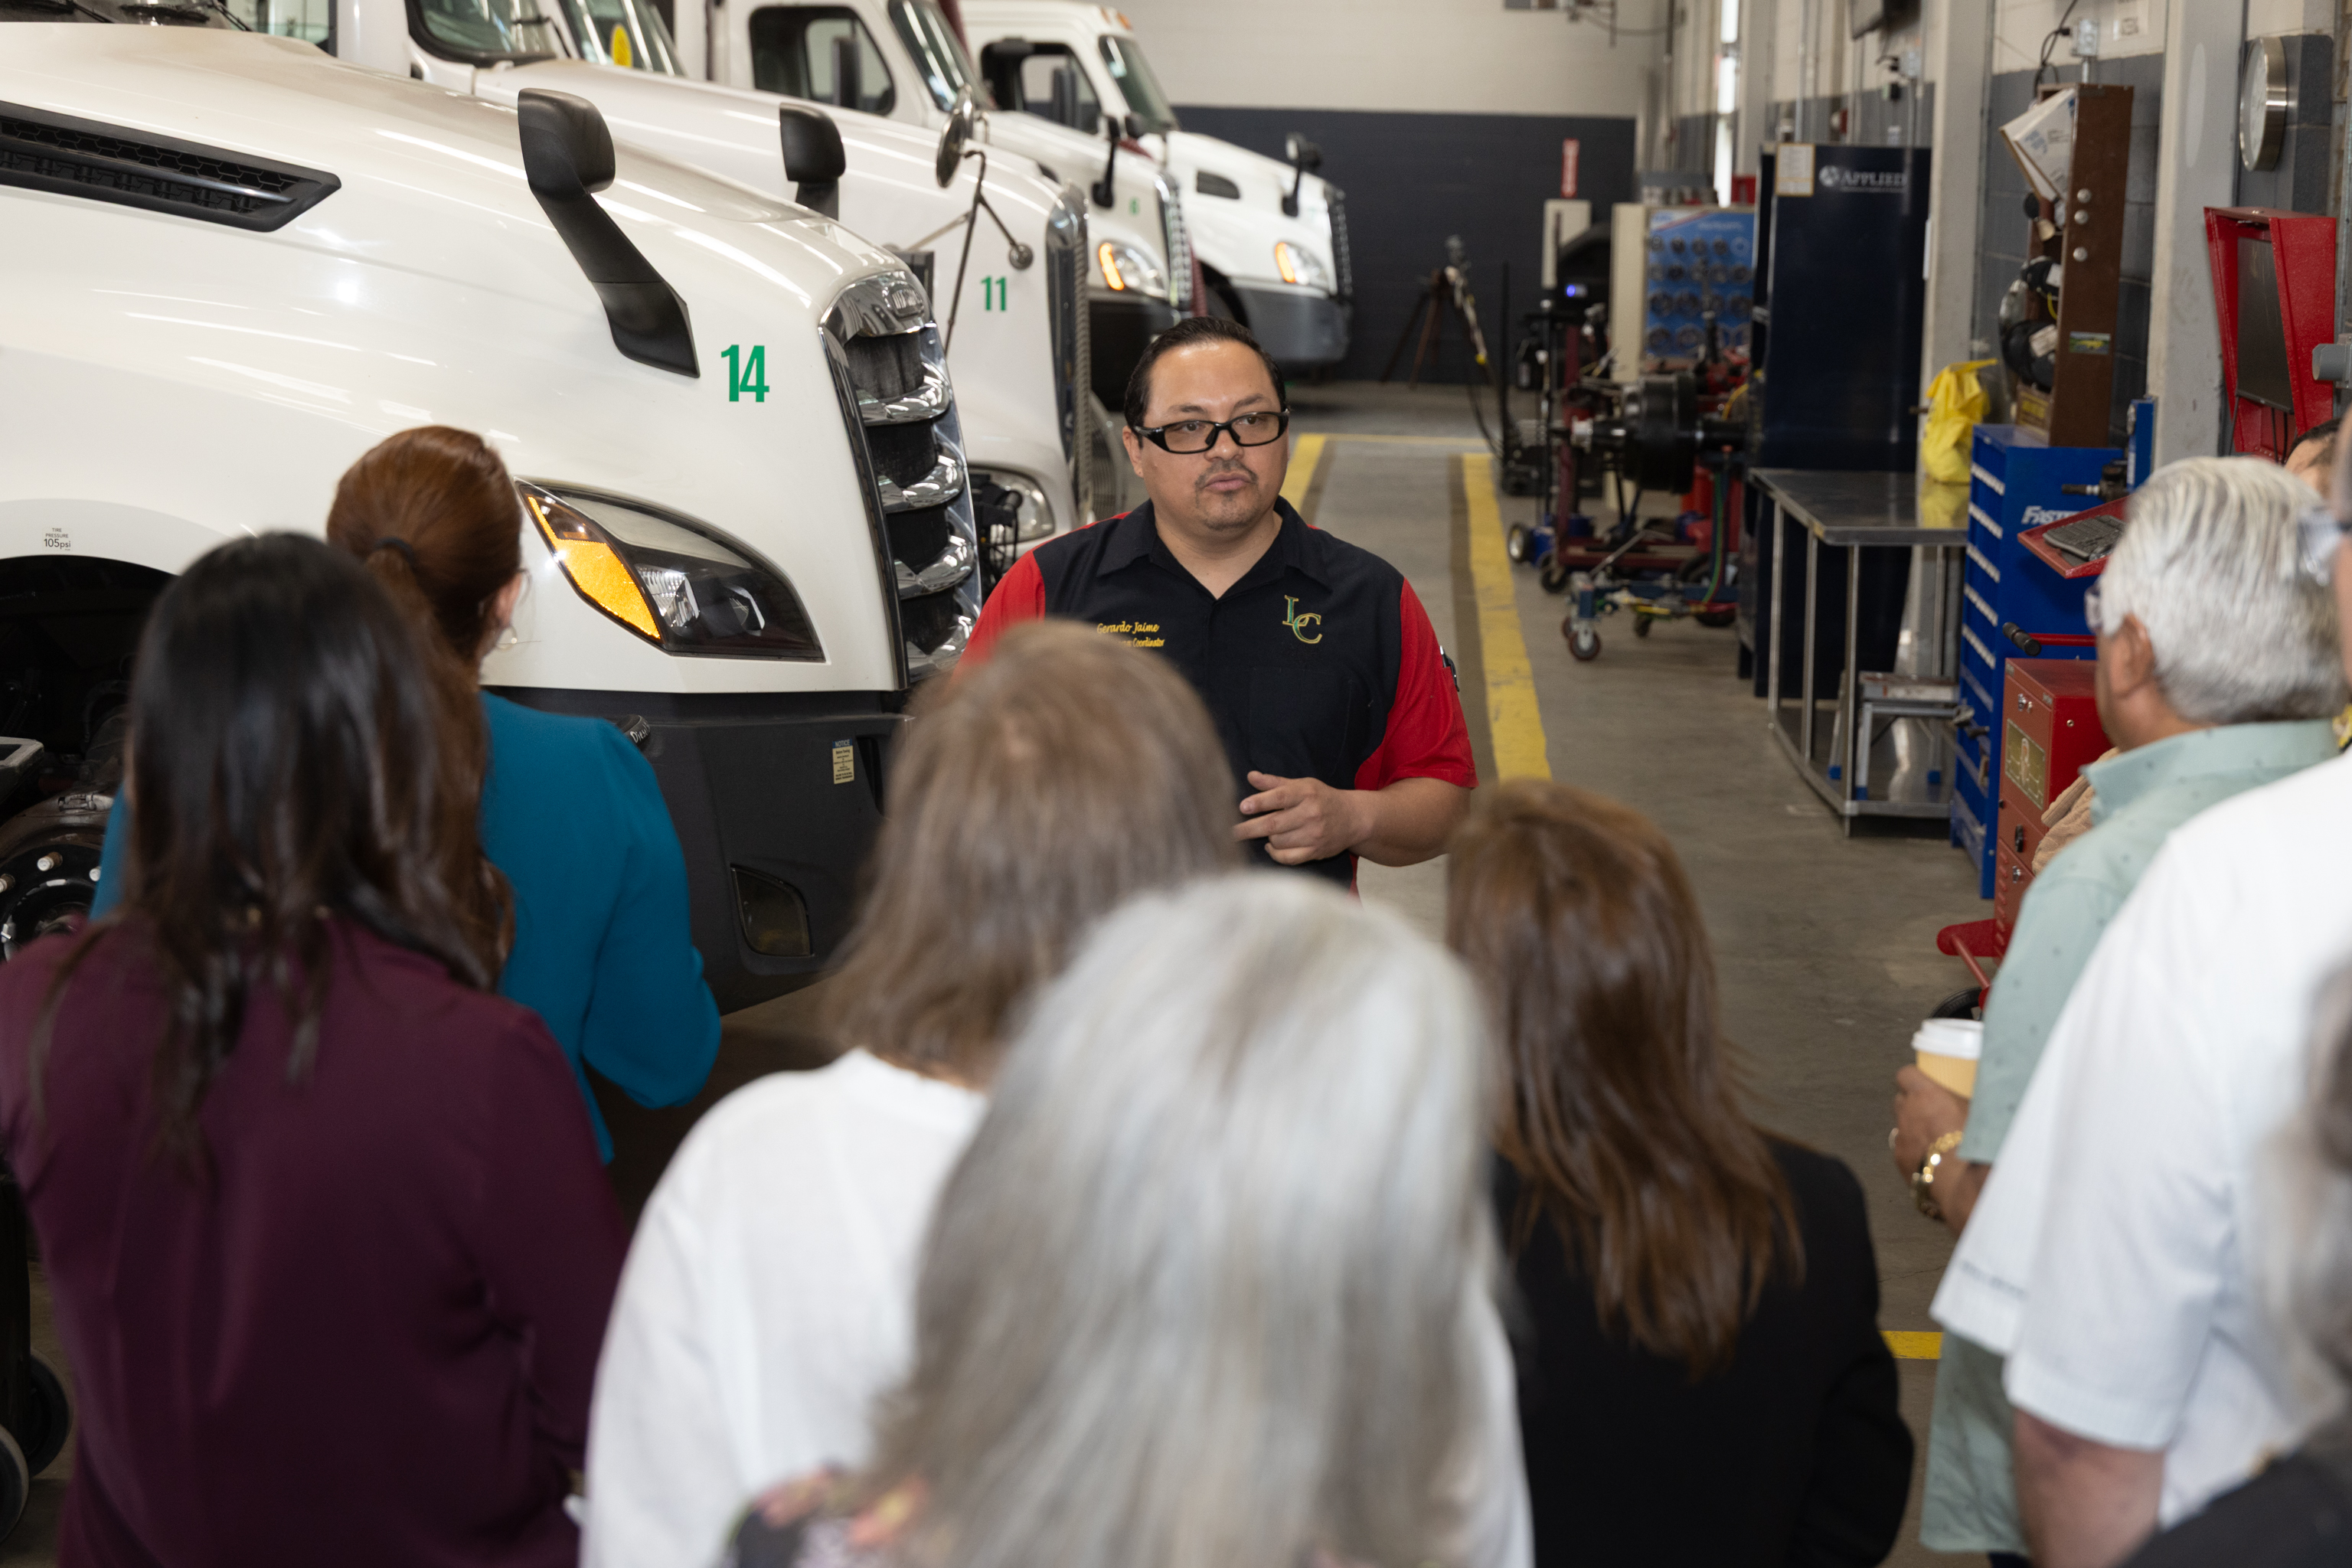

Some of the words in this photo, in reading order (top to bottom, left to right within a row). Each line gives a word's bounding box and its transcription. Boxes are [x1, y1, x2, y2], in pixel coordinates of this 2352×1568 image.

[981, 276, 1006, 311] 11
[721, 345, 769, 402] 14
[44, 538, 70, 550] 105psi
[1096, 621, 1132, 634] Gerardo
[1132, 622, 1160, 634] Jaime
